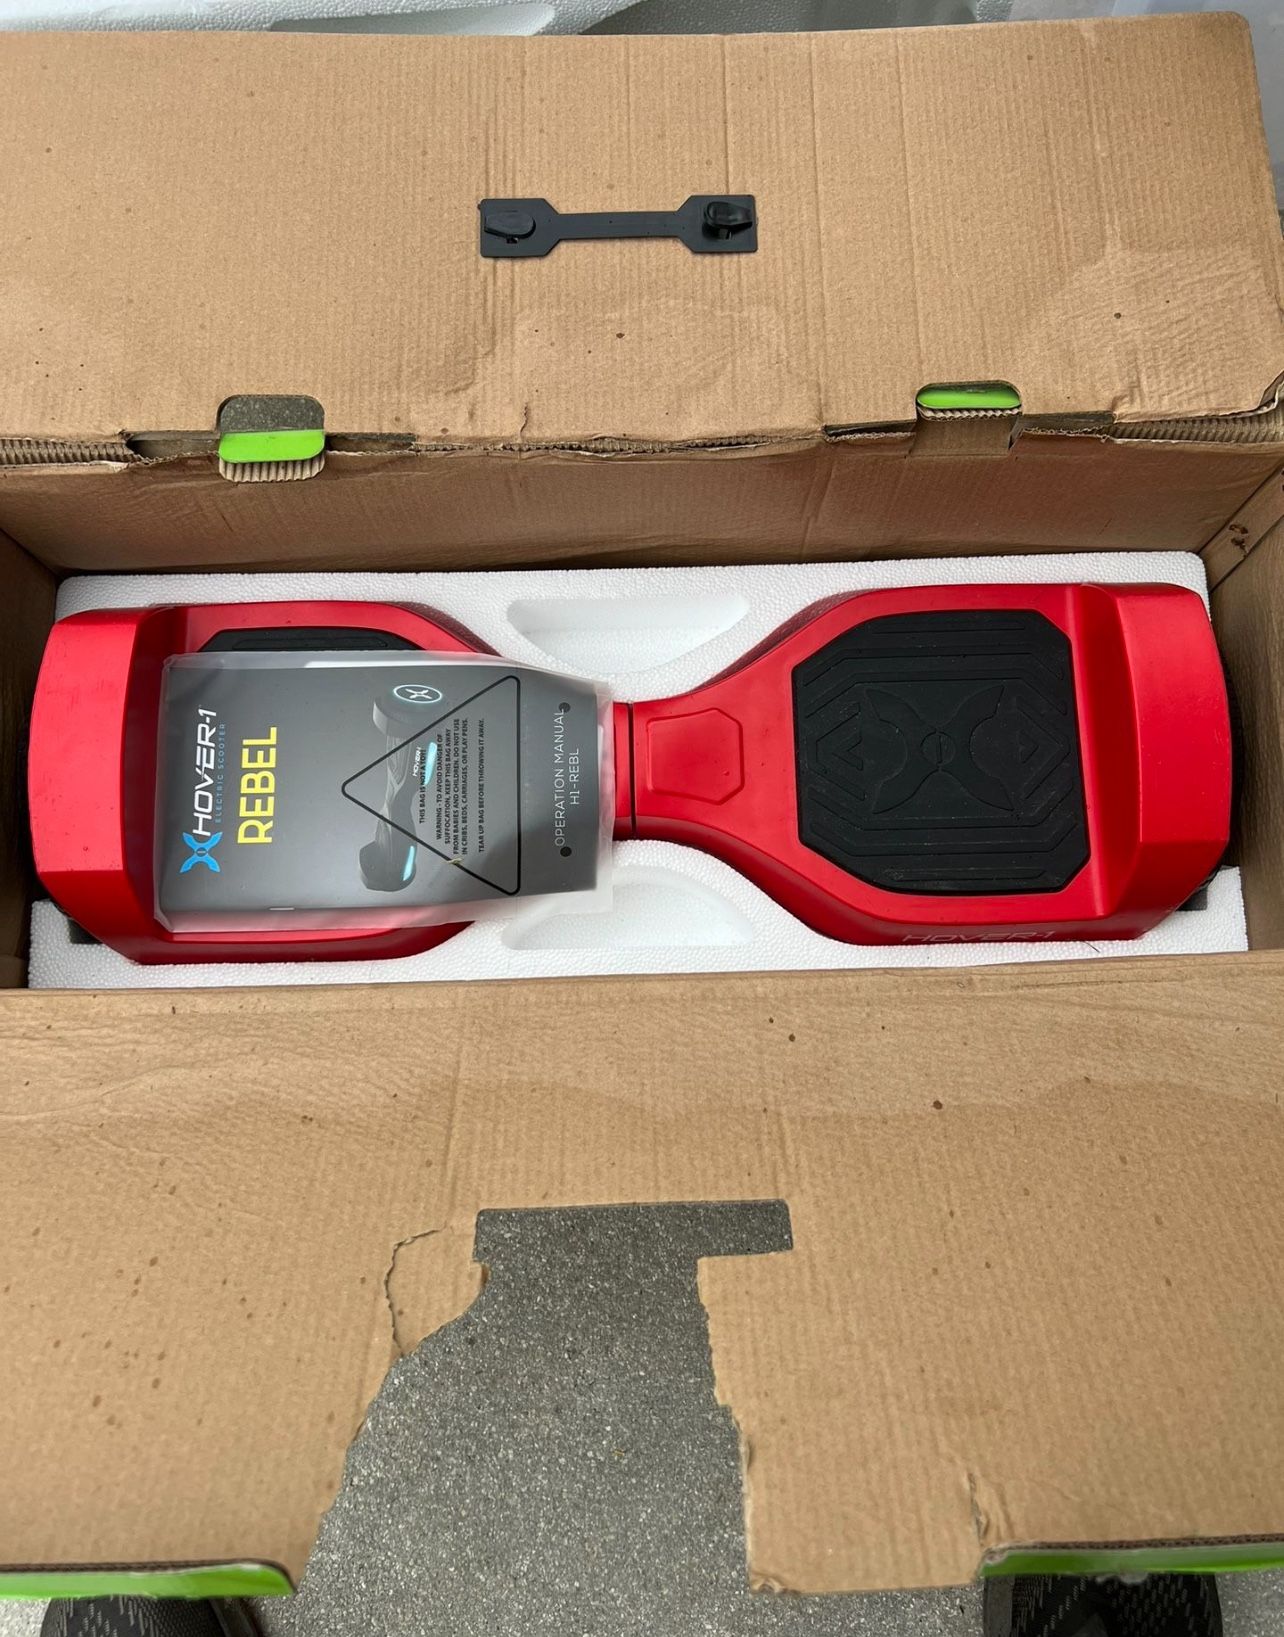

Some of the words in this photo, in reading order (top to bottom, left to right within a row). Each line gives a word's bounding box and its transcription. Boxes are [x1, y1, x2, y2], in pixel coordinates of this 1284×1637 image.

[218, 723, 226, 769] SCOOTER
[436, 734, 443, 742] OF
[453, 747, 459, 757] DO
[462, 755, 468, 764] OR
[554, 709, 565, 764] MANUAL
[193, 709, 217, 837] HOVER-1
[237, 727, 277, 844] REBEL
[569, 748, 580, 805] H1-REBL
[215, 775, 225, 824] ELECTRIC
[436, 794, 443, 803] TO
[554, 769, 566, 847] OPERATION
[479, 825, 485, 834] UP
[902, 931, 1056, 943] HOVER-1
